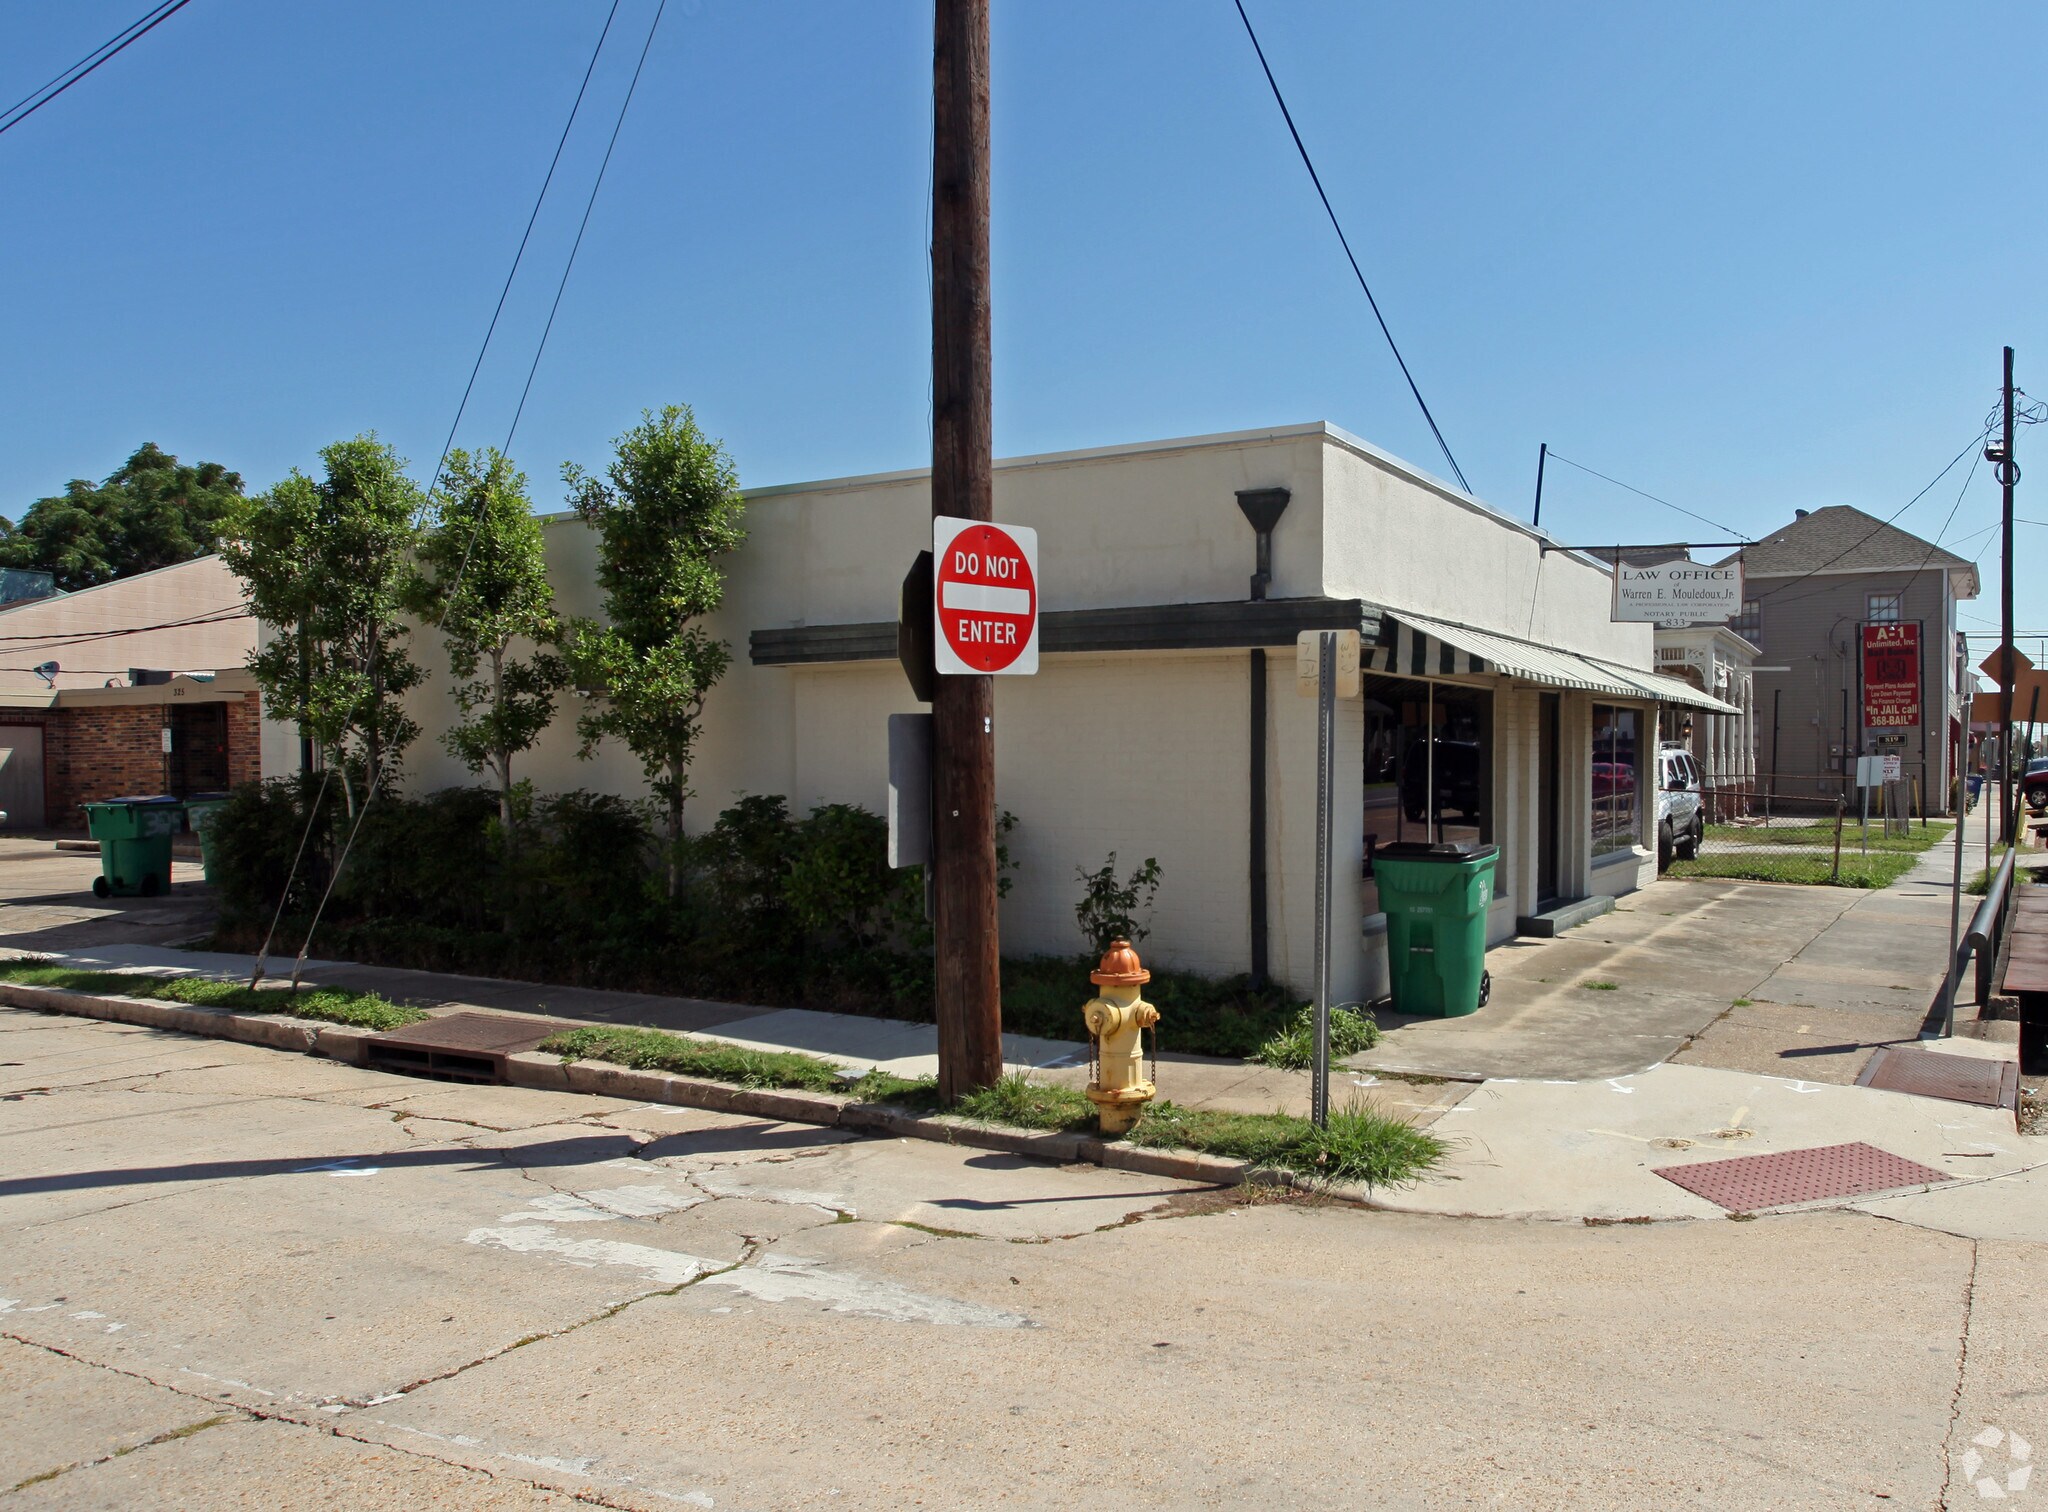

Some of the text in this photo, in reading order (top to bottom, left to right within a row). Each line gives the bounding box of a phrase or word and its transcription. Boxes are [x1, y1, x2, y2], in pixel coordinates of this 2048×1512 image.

[955, 551, 1019, 579] DO NOT
[1623, 570, 1735, 580] LAW OFFICE
[1622, 588, 1652, 599] Warren
[1657, 588, 1666, 599] E.
[1665, 618, 1686, 627] 833
[959, 619, 1016, 644] ENTER
[1877, 626, 1904, 640] A-1
[1867, 639, 1902, 648] Unlimited,
[173, 688, 185, 696] 325
[1881, 705, 1899, 715] JAIL
[1902, 704, 1917, 714] call
